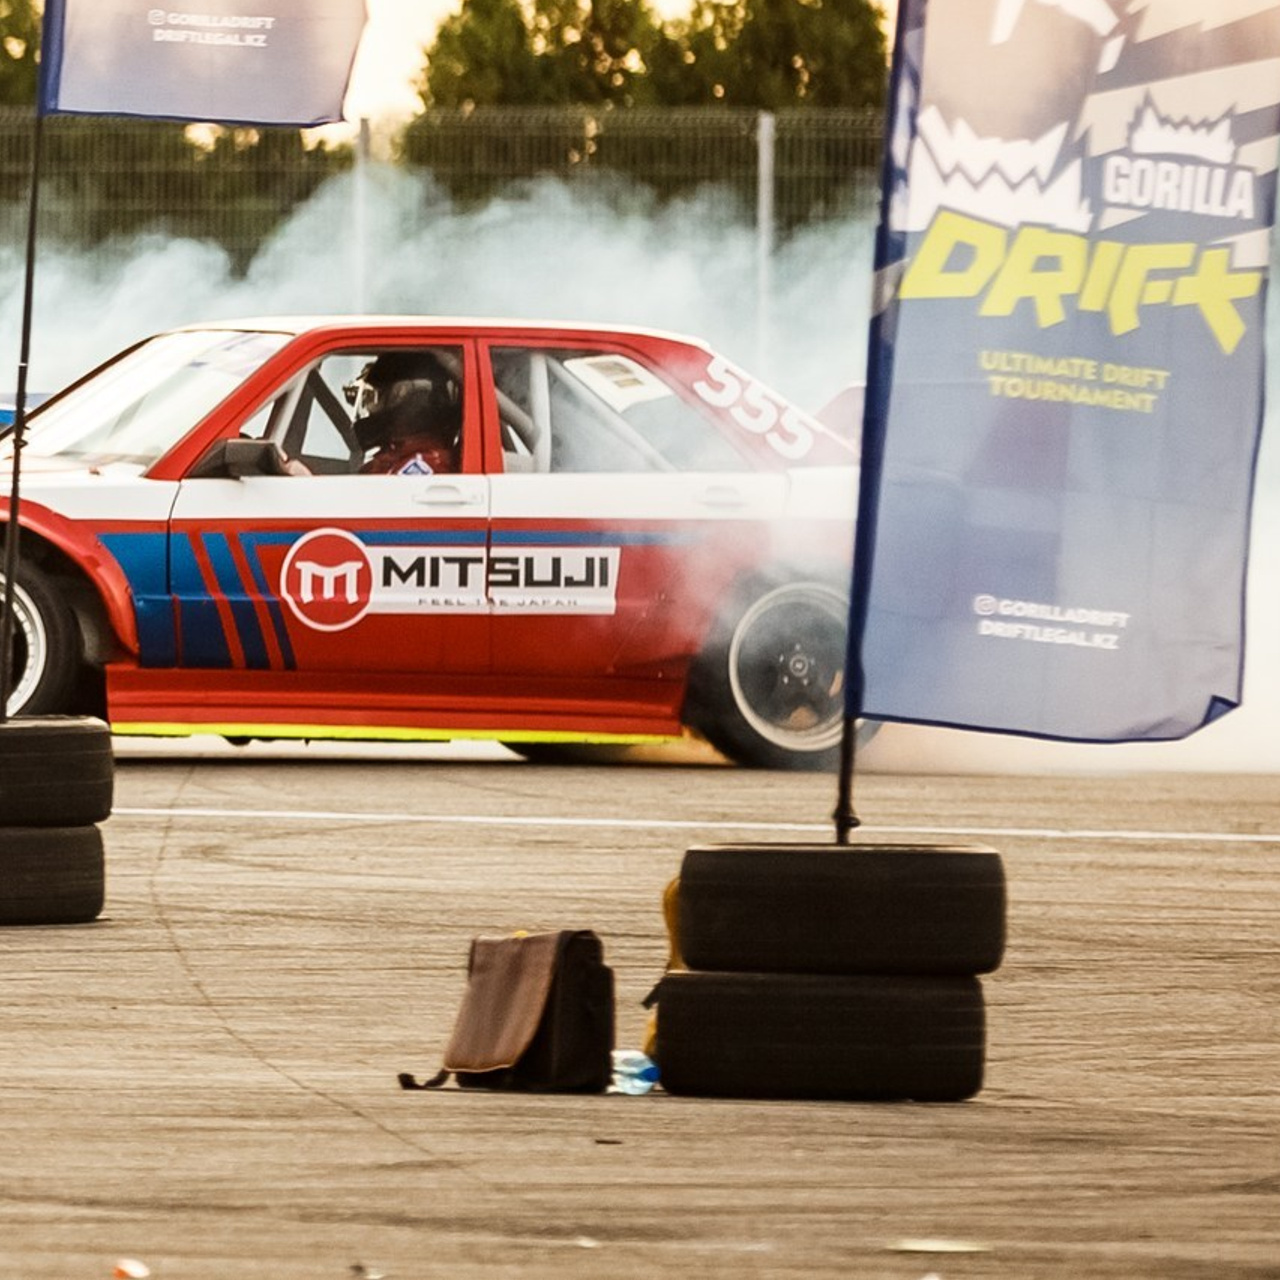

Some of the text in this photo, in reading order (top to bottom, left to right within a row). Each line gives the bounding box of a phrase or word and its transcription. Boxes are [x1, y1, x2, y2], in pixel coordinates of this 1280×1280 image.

[1104, 156, 1255, 219] GORILLA
[898, 209, 1262, 355] DRIFT
[980, 351, 1171, 390] ULTIMATE DRIFT
[989, 375, 1158, 414] TOURNAMENT
[692, 356, 816, 460] 555
[382, 556, 608, 588] MITSUJI
